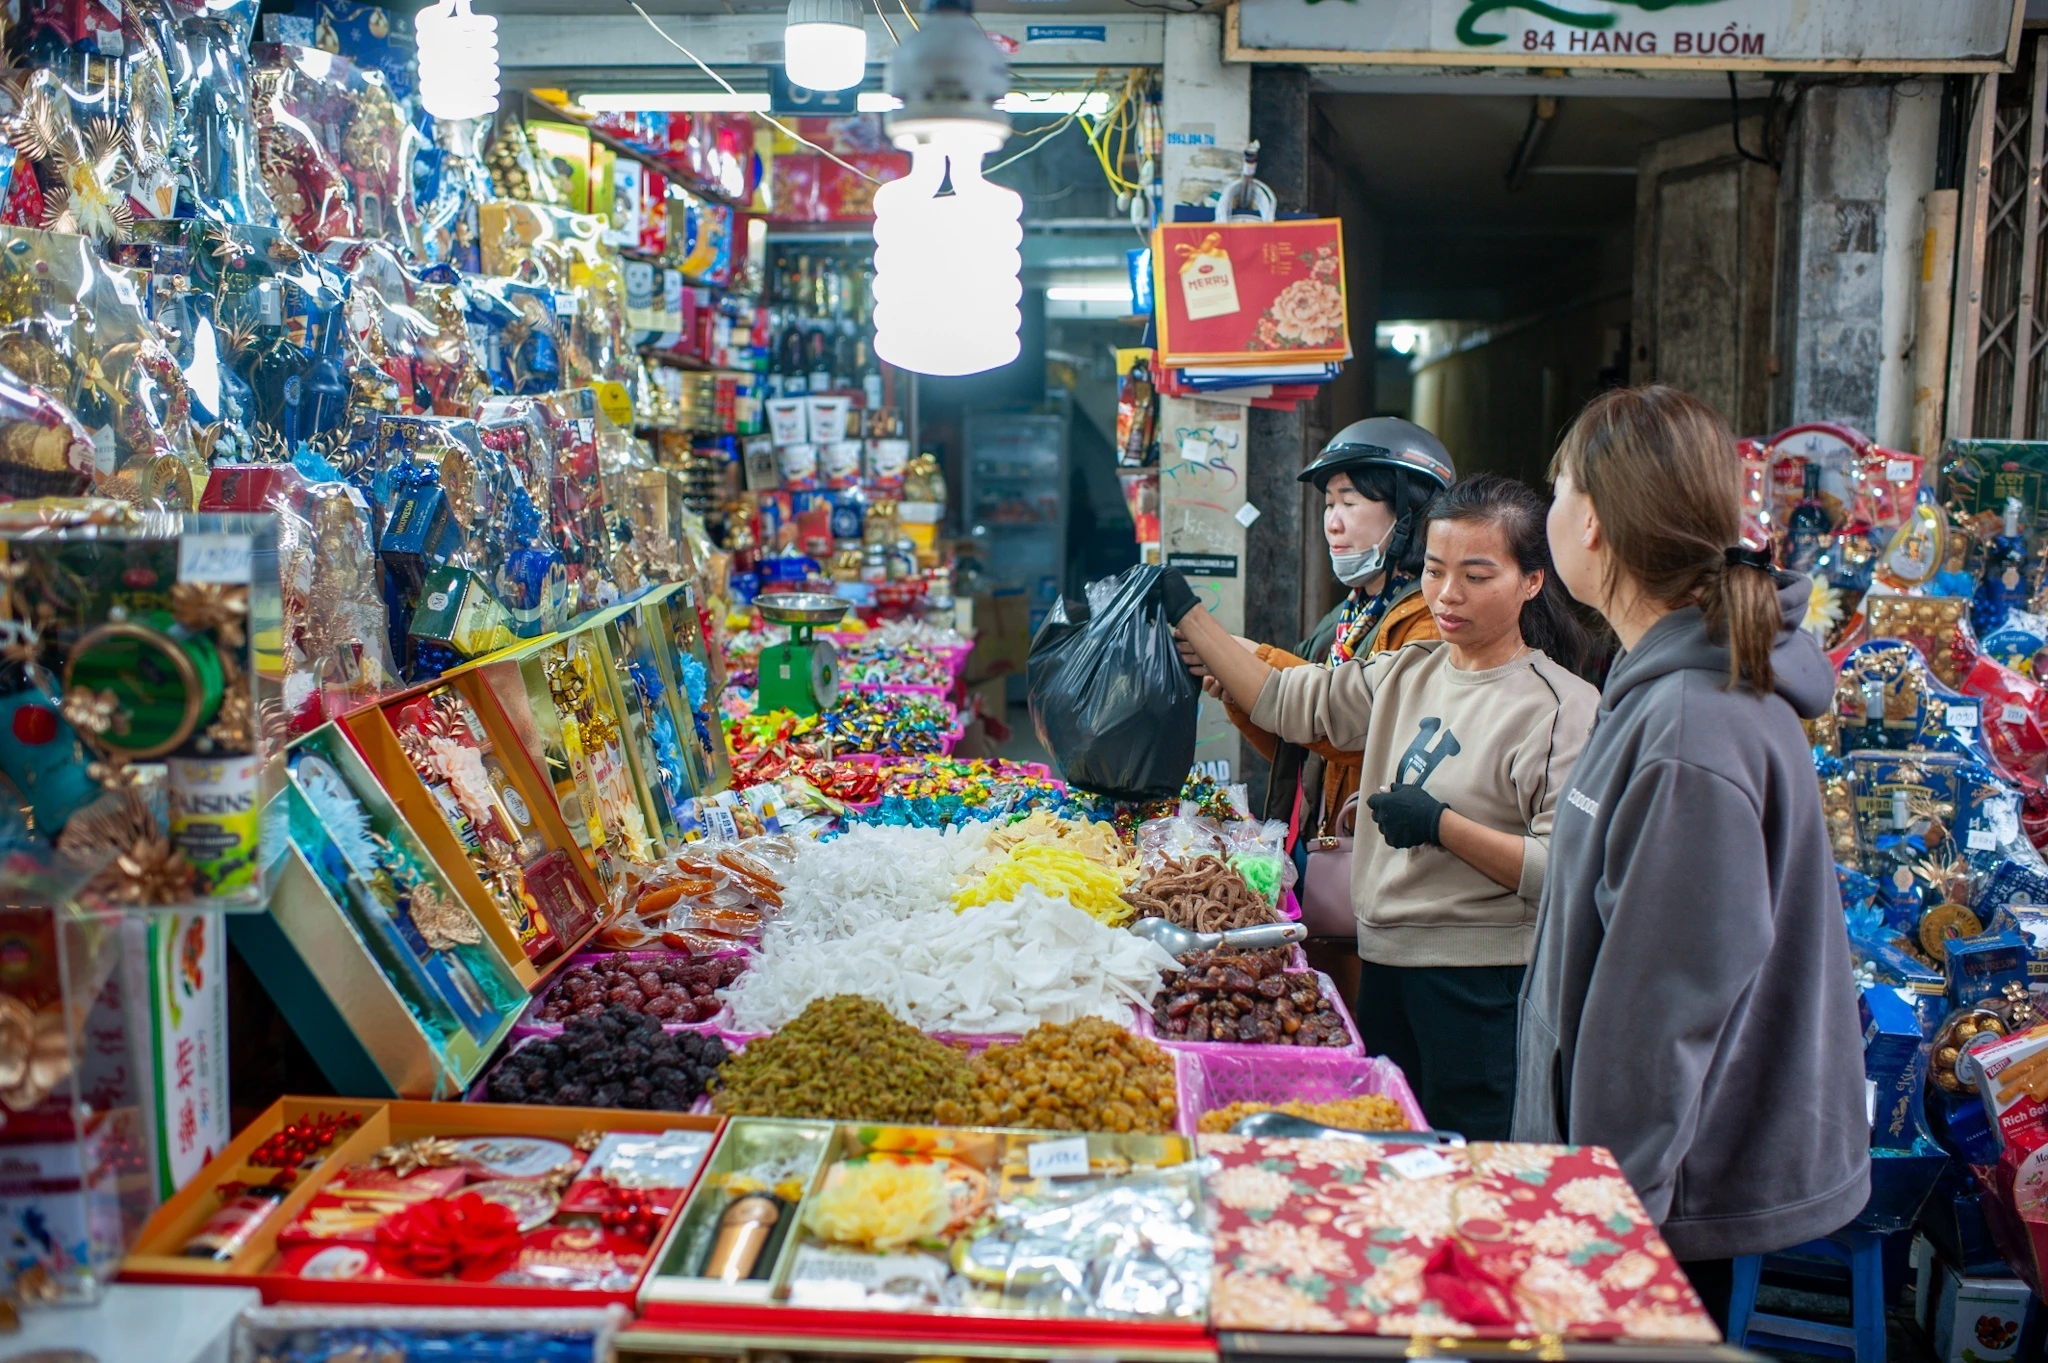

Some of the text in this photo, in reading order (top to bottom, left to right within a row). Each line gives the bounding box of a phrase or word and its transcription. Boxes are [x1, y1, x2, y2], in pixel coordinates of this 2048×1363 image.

[1522, 30, 1556, 51] 84
[1568, 31, 1657, 54] HANG
[1188, 274, 1229, 290] MERRY
[2001, 1103, 2048, 1128] Rich Gol
